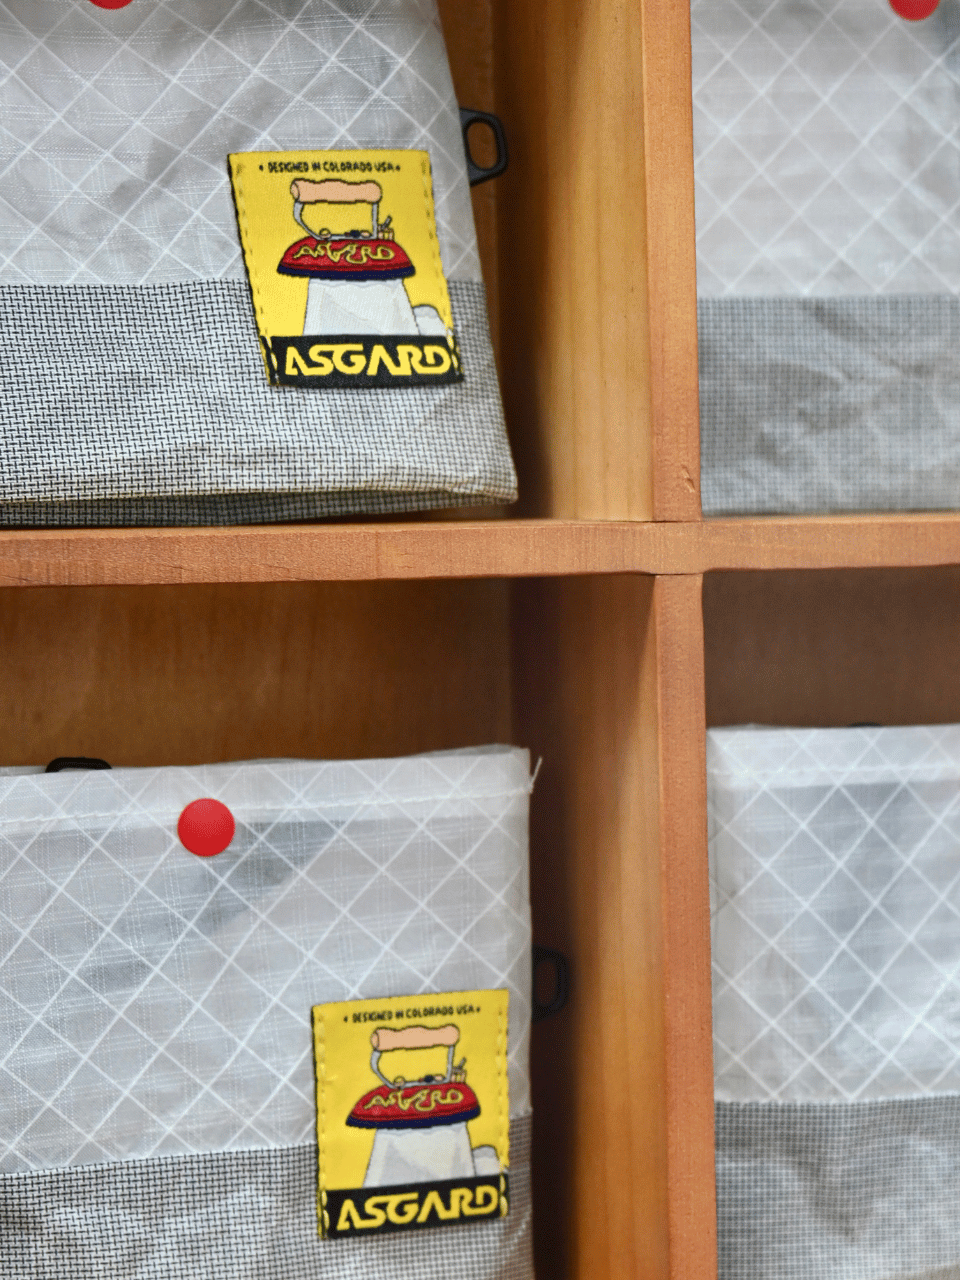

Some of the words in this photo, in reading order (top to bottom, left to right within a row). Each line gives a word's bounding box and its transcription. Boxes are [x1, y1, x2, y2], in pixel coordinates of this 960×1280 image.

[268, 162, 309, 173] DESIGNED
[311, 162, 321, 172] IN
[323, 161, 372, 172] COLORADO
[374, 162, 393, 172] USA
[285, 344, 452, 376] ASGARD
[352, 1011, 393, 1023] DESIGNED
[395, 1008, 404, 1019] IN
[406, 1006, 454, 1018] COLORADO
[456, 1004, 475, 1015] USA
[336, 1185, 499, 1231] ASGARD
